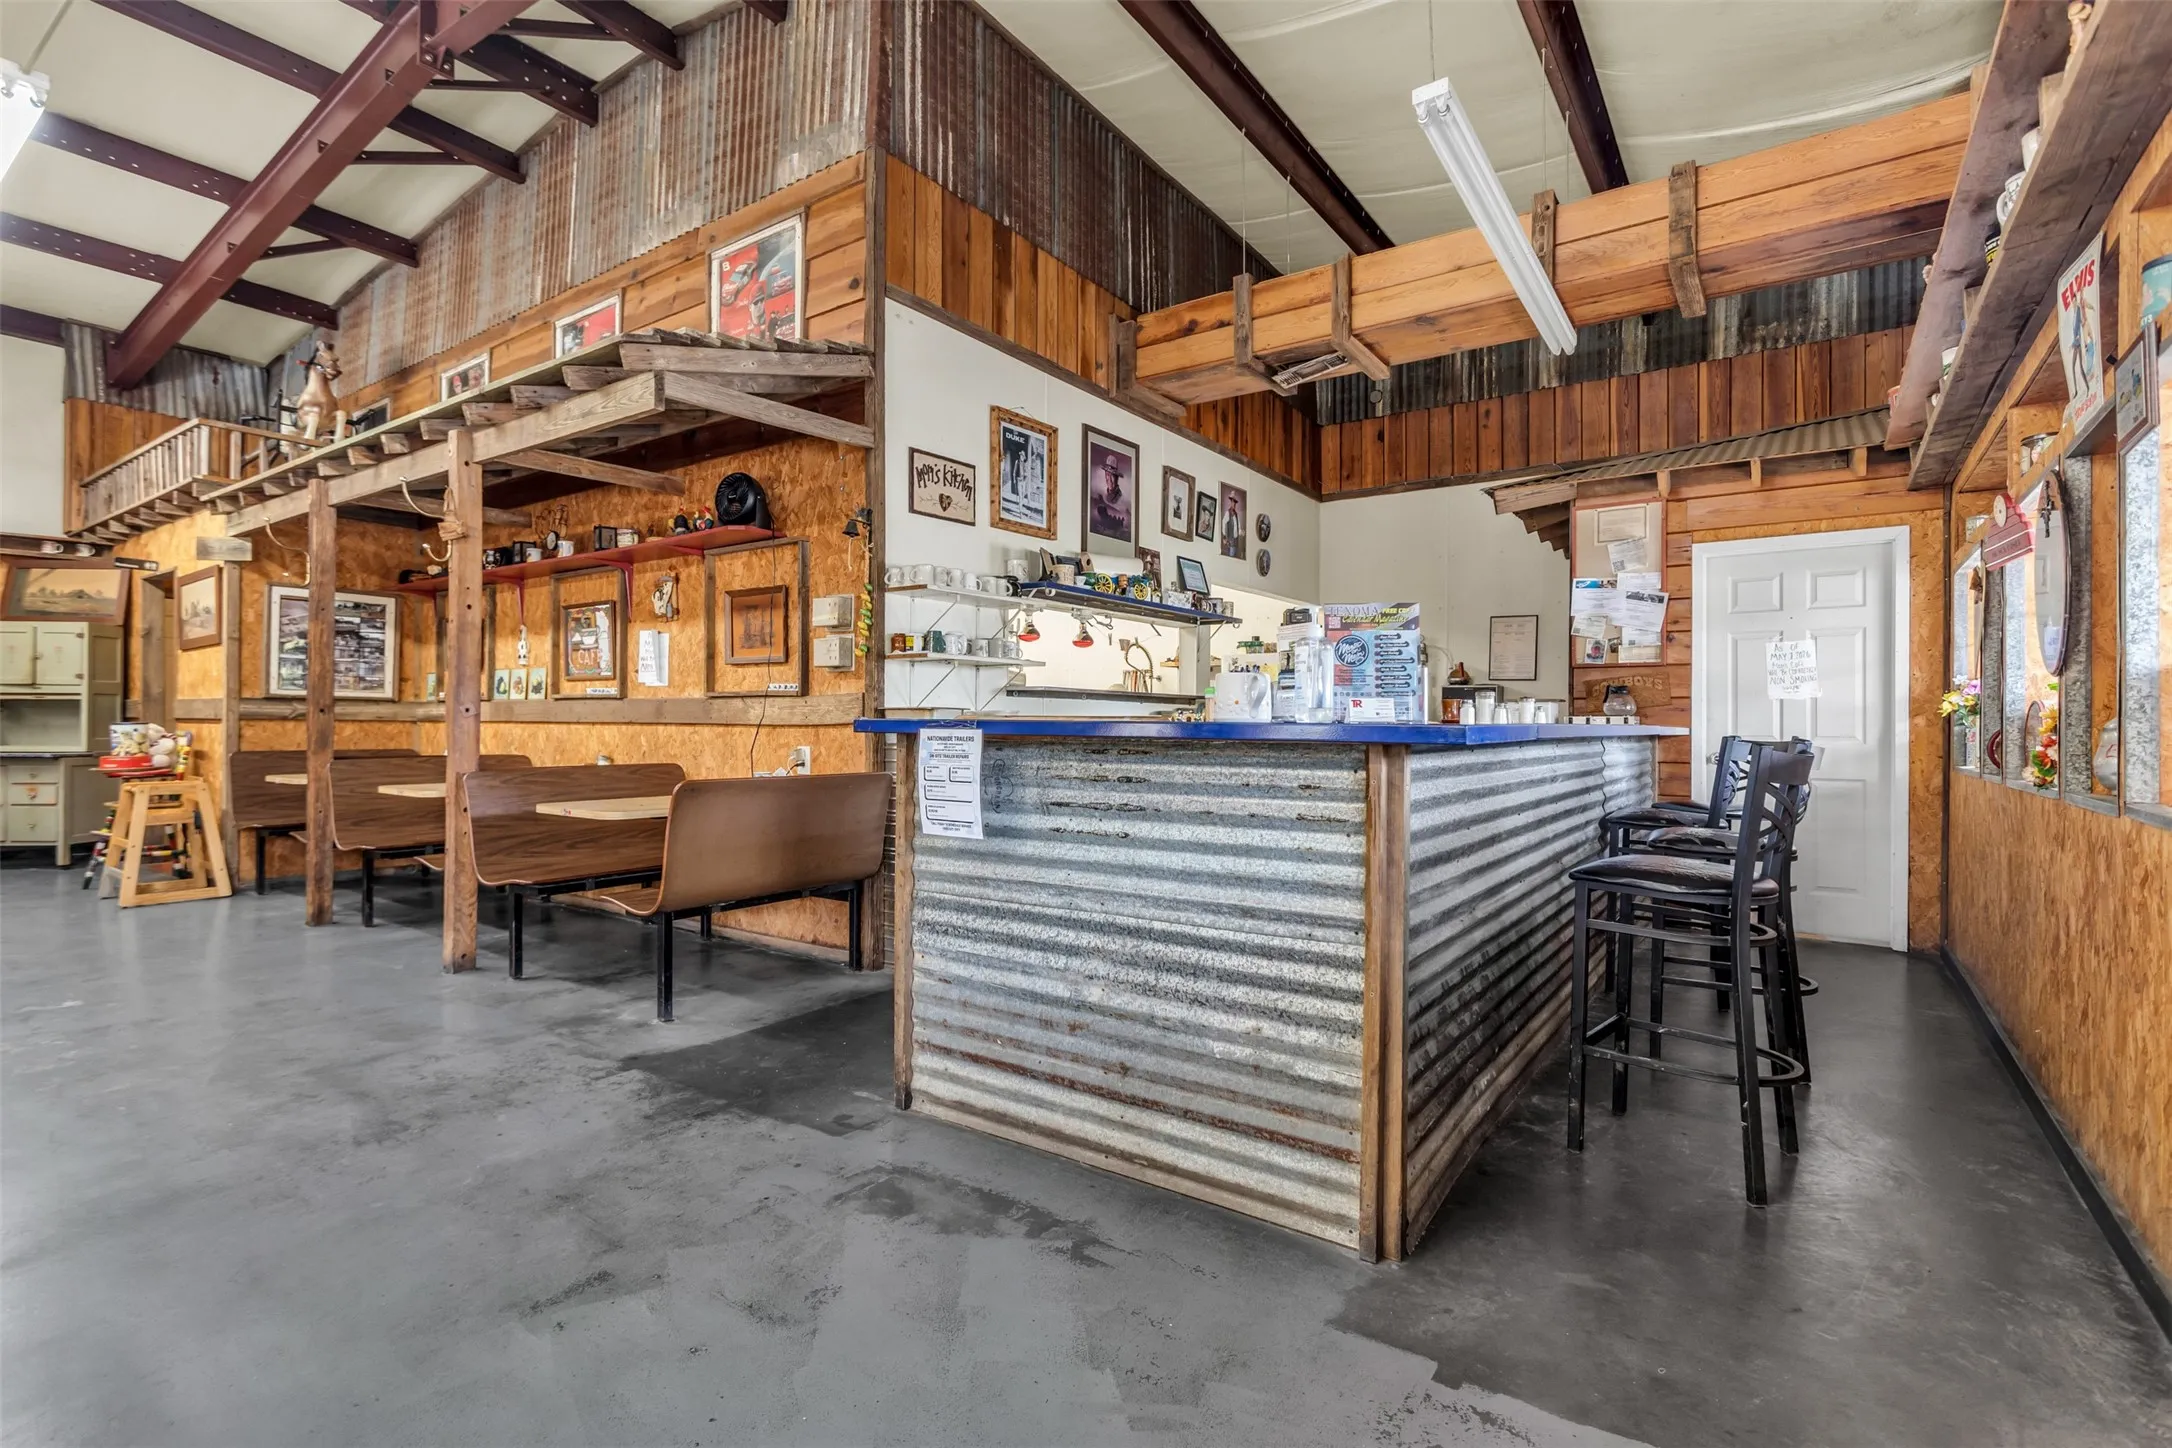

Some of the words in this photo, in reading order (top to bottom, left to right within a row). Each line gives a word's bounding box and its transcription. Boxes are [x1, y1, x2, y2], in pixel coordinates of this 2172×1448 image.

[2061, 259, 2096, 312] ELVIS
[1005, 432, 1026, 444] DUKE
[1328, 606, 1379, 616] TEXOMA
